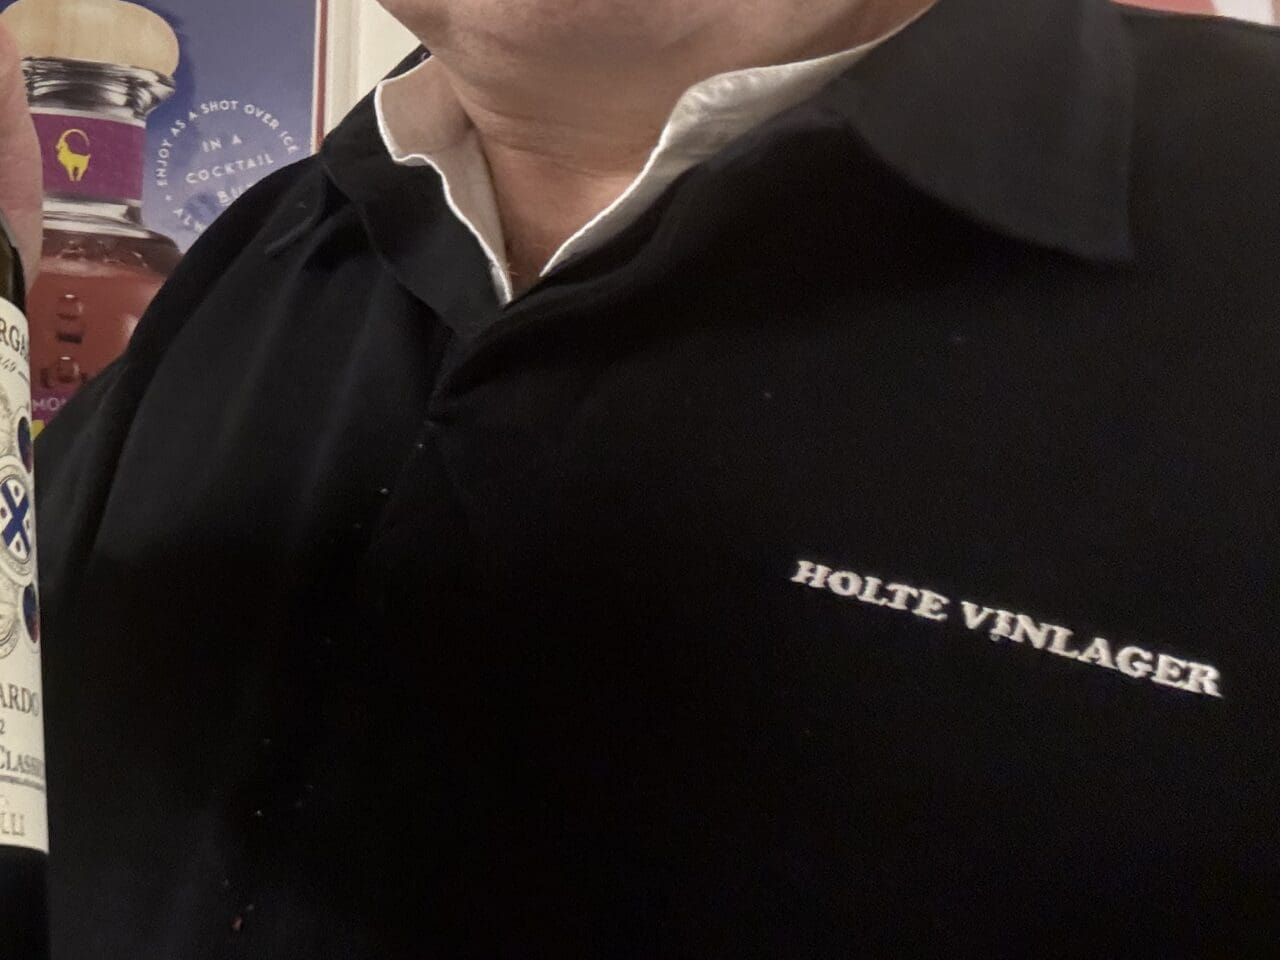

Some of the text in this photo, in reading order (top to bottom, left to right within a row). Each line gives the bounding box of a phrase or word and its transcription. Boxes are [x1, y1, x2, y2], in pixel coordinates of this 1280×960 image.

[156, 100, 299, 186] ENJOY AS A SHOT OVER ICE
[185, 153, 274, 184] COCKTAIL
[202, 134, 243, 152] IN A
[790, 559, 1224, 699] HOLTE VINLAGER
